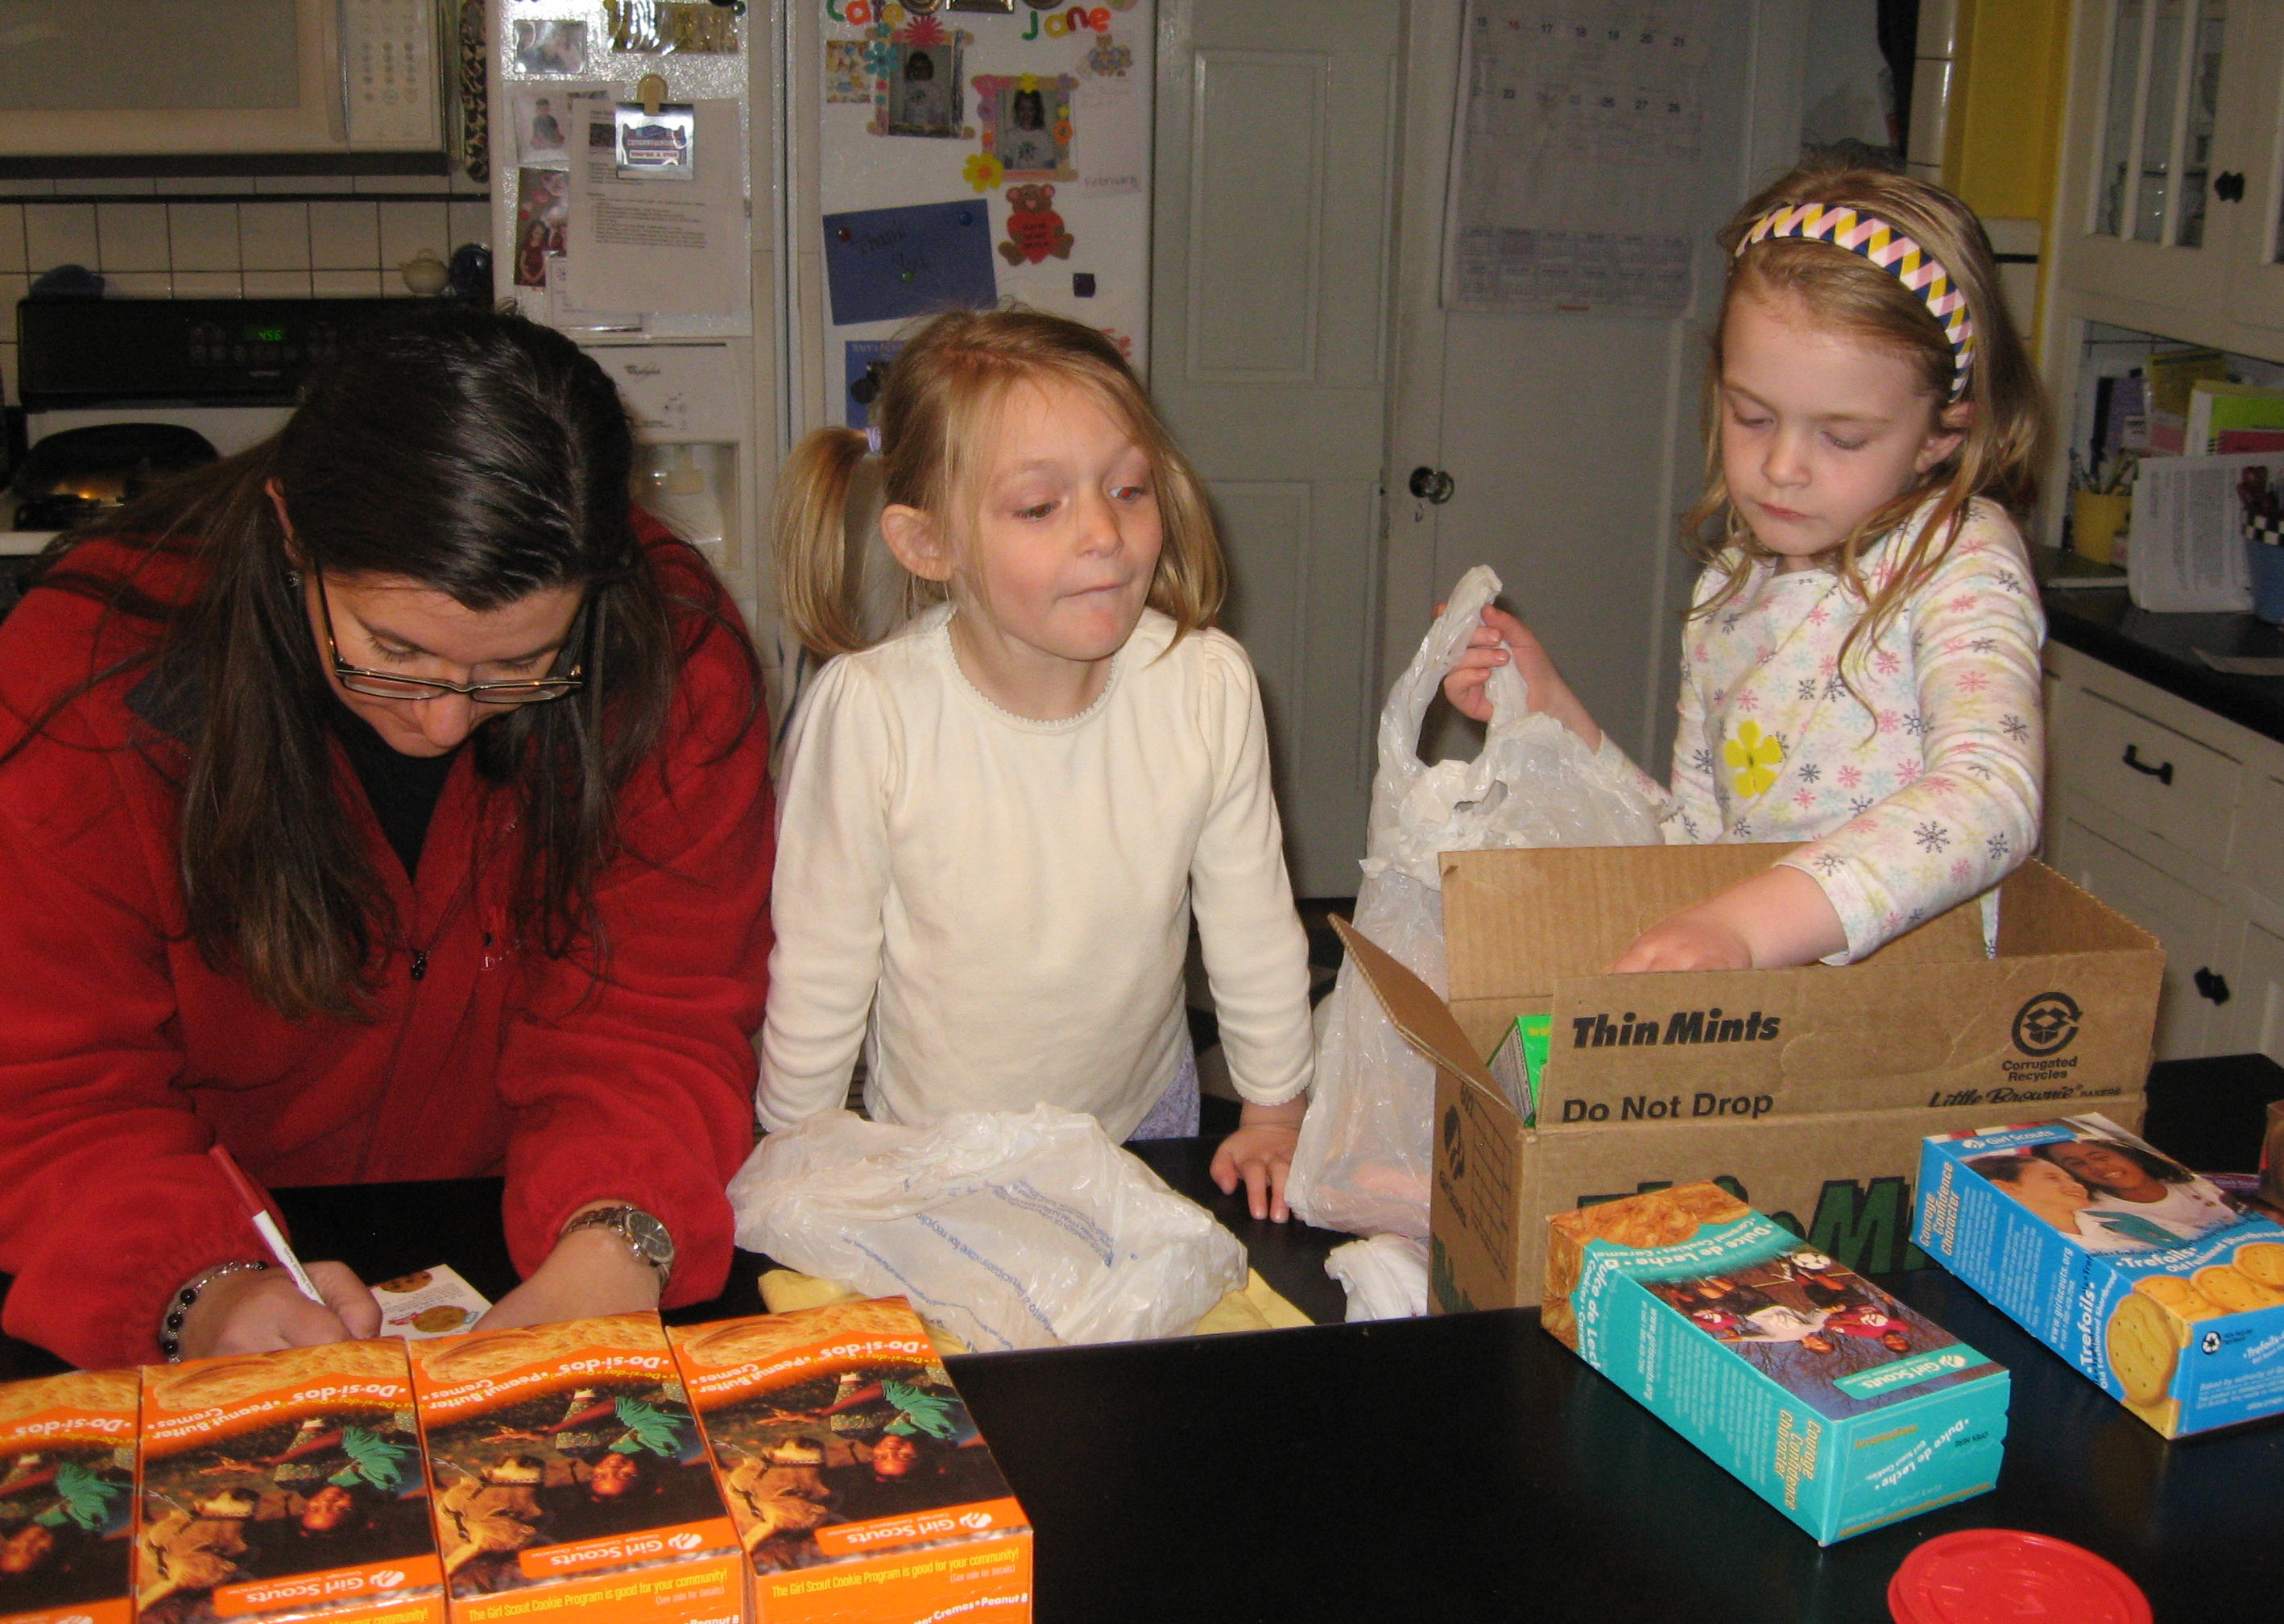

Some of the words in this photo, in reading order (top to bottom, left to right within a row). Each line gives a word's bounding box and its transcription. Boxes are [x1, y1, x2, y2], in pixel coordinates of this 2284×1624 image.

[1021, 6, 1111, 40] Jane
[1574, 1012, 1659, 1048] Thin
[1662, 1008, 1781, 1045] Mints
[2002, 1056, 2077, 1071] Corrugated
[2009, 1069, 2067, 1082] Recycles
[1562, 1099, 1609, 1123] Do
[1621, 1096, 1681, 1120] Not
[1693, 1093, 1773, 1119] Drop
[1928, 1089, 1983, 1107] Little
[1985, 1135, 2009, 1146] Girl
[2011, 1130, 2054, 1142] Scouts
[1933, 1161, 1954, 1236] Confidence
[1919, 1193, 1936, 1247] Courage
[1940, 1193, 1959, 1256] Character
[1727, 1227, 1770, 1249] Dulce
[1634, 1252, 1700, 1267] Leche
[1700, 1246, 1723, 1257] de
[2121, 1248, 2195, 1268] Trefoils
[1591, 1258, 1620, 1298] Dulce
[2050, 1246, 2074, 1343] www.girlscouts.org
[1587, 1300, 1599, 1324] de
[2078, 1288, 2096, 1367] Trefoils
[698, 1362, 759, 1383] Cremes
[750, 1357, 805, 1383] Peanut
[1862, 1370, 1914, 1389] Scouts
[1910, 1362, 1941, 1377] Girl
[430, 1379, 494, 1399] Cremes
[482, 1372, 542, 1399] Peanut
[698, 1375, 754, 1394] Butter
[428, 1391, 485, 1410] Butter
[156, 1407, 223, 1428] Cremes
[213, 1401, 275, 1428] Peanut
[152, 1419, 212, 1440] Butter
[1934, 1419, 1965, 1448] Dulce
[1774, 1409, 1794, 1480] Character
[1799, 1419, 1822, 1480] Courage
[1917, 1448, 1932, 1463] de
[1785, 1432, 1804, 1510] Confidence
[1881, 1461, 1916, 1487] Leche
[846, 1525, 916, 1544] Scouts
[920, 1519, 955, 1535] Girl
[551, 1546, 621, 1565] Scouts
[626, 1539, 664, 1556] Girl
[772, 1585, 789, 1598] The
[789, 1582, 805, 1595] Girl
[805, 1578, 831, 1593] Scout
[832, 1574, 863, 1589] Cookie
[863, 1568, 901, 1586] Program
[902, 1564, 910, 1577] is
[911, 1561, 933, 1578] good
[934, 1558, 947, 1571] for
[948, 1559, 968, 1574] your
[969, 1548, 1020, 1567] community!
[246, 1585, 321, 1603] Scouts
[325, 1577, 363, 1593] Girl
[469, 1608, 486, 1622] The
[487, 1604, 503, 1618] Girl
[503, 1601, 531, 1617] Scout
[532, 1597, 564, 1612] Cookie
[564, 1590, 604, 1610] Program
[605, 1586, 613, 1598] is
[614, 1583, 639, 1599] good
[639, 1579, 652, 1594] for
[653, 1580, 673, 1597] your
[675, 1568, 728, 1589] community!
[933, 1601, 974, 1620] Cremes
[981, 1595, 1019, 1607] Peanut
